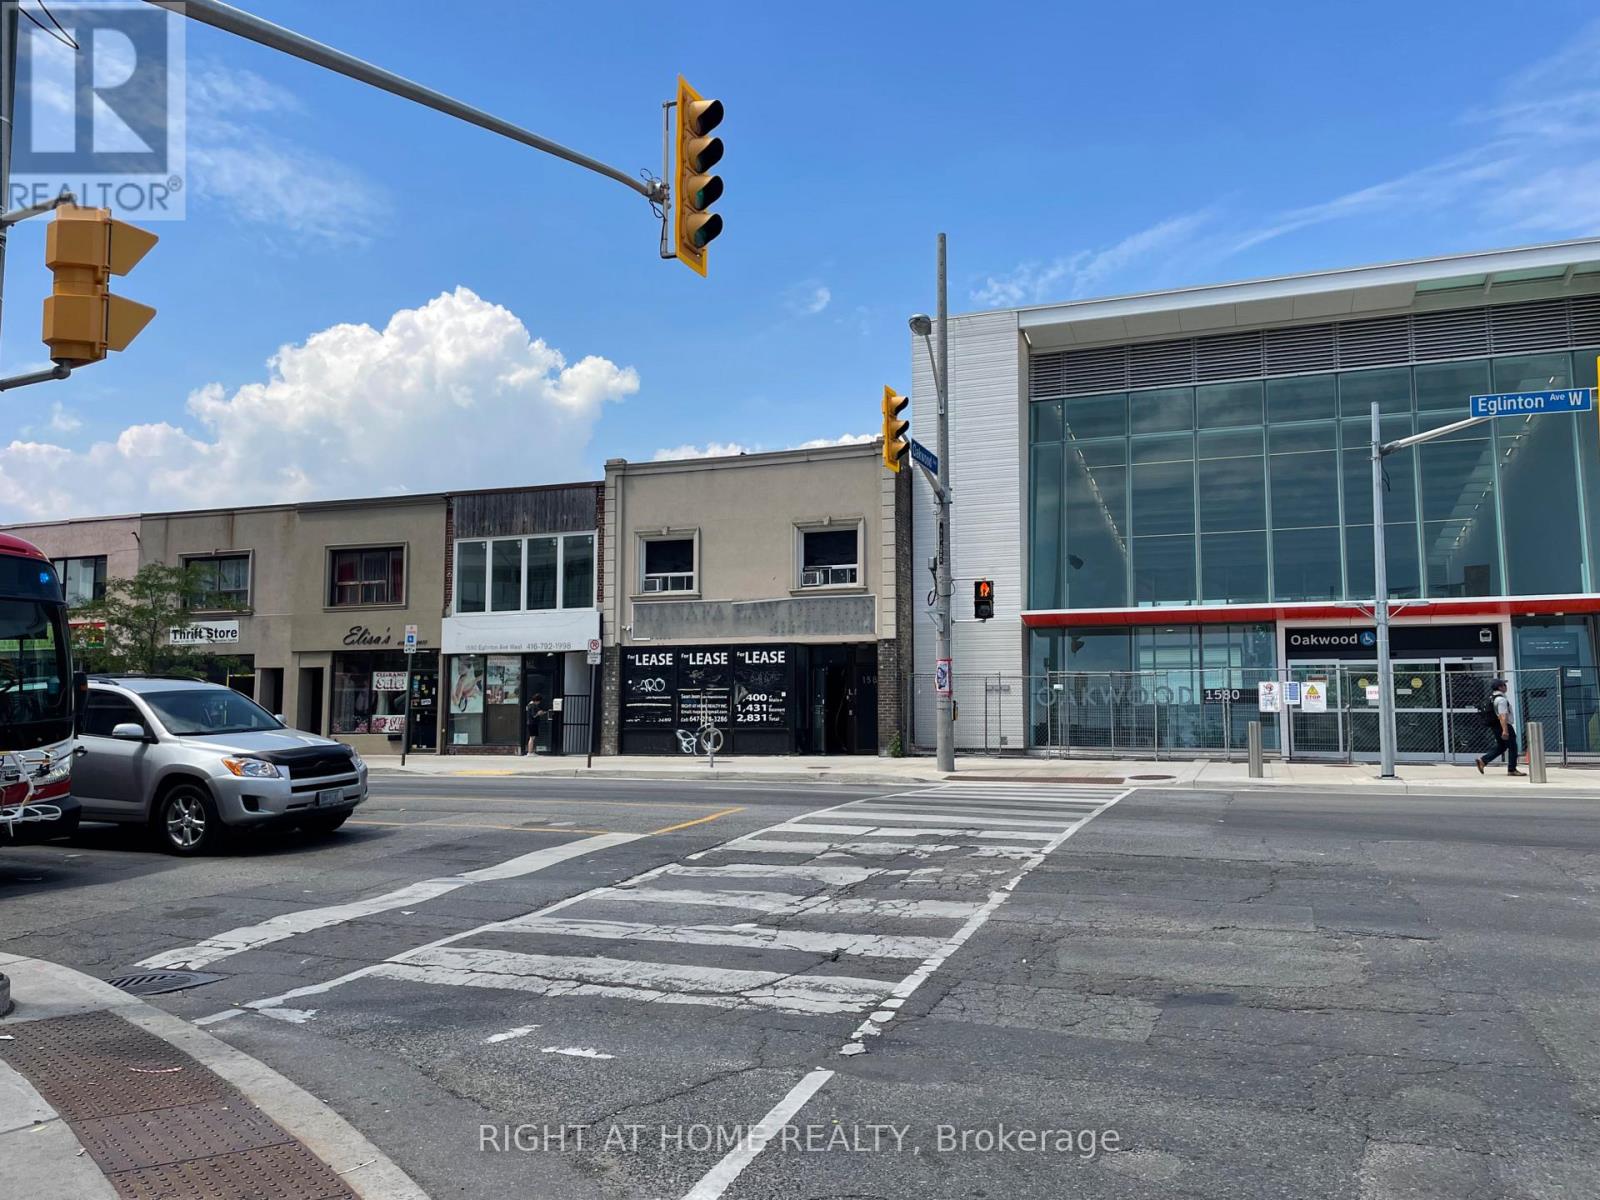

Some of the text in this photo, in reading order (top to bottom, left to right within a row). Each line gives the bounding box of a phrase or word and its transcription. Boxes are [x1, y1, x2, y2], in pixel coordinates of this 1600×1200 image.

[1478, 391, 1583, 415] Eglinton Ave W
[171, 627, 238, 640] Thrift Store
[343, 626, 391, 646] Elisa's
[1290, 633, 1358, 646] Oakwood
[526, 642, 572, 650] 416-792-1998
[635, 653, 673, 666] LEASE
[689, 652, 728, 665] LEASE
[745, 651, 786, 664] LEASE
[740, 693, 767, 702] ,400
[1037, 685, 1193, 706] OAKWOOD
[1205, 689, 1240, 700] 1580
[736, 704, 767, 713] 1,431
[736, 713, 767, 723] 2,831
